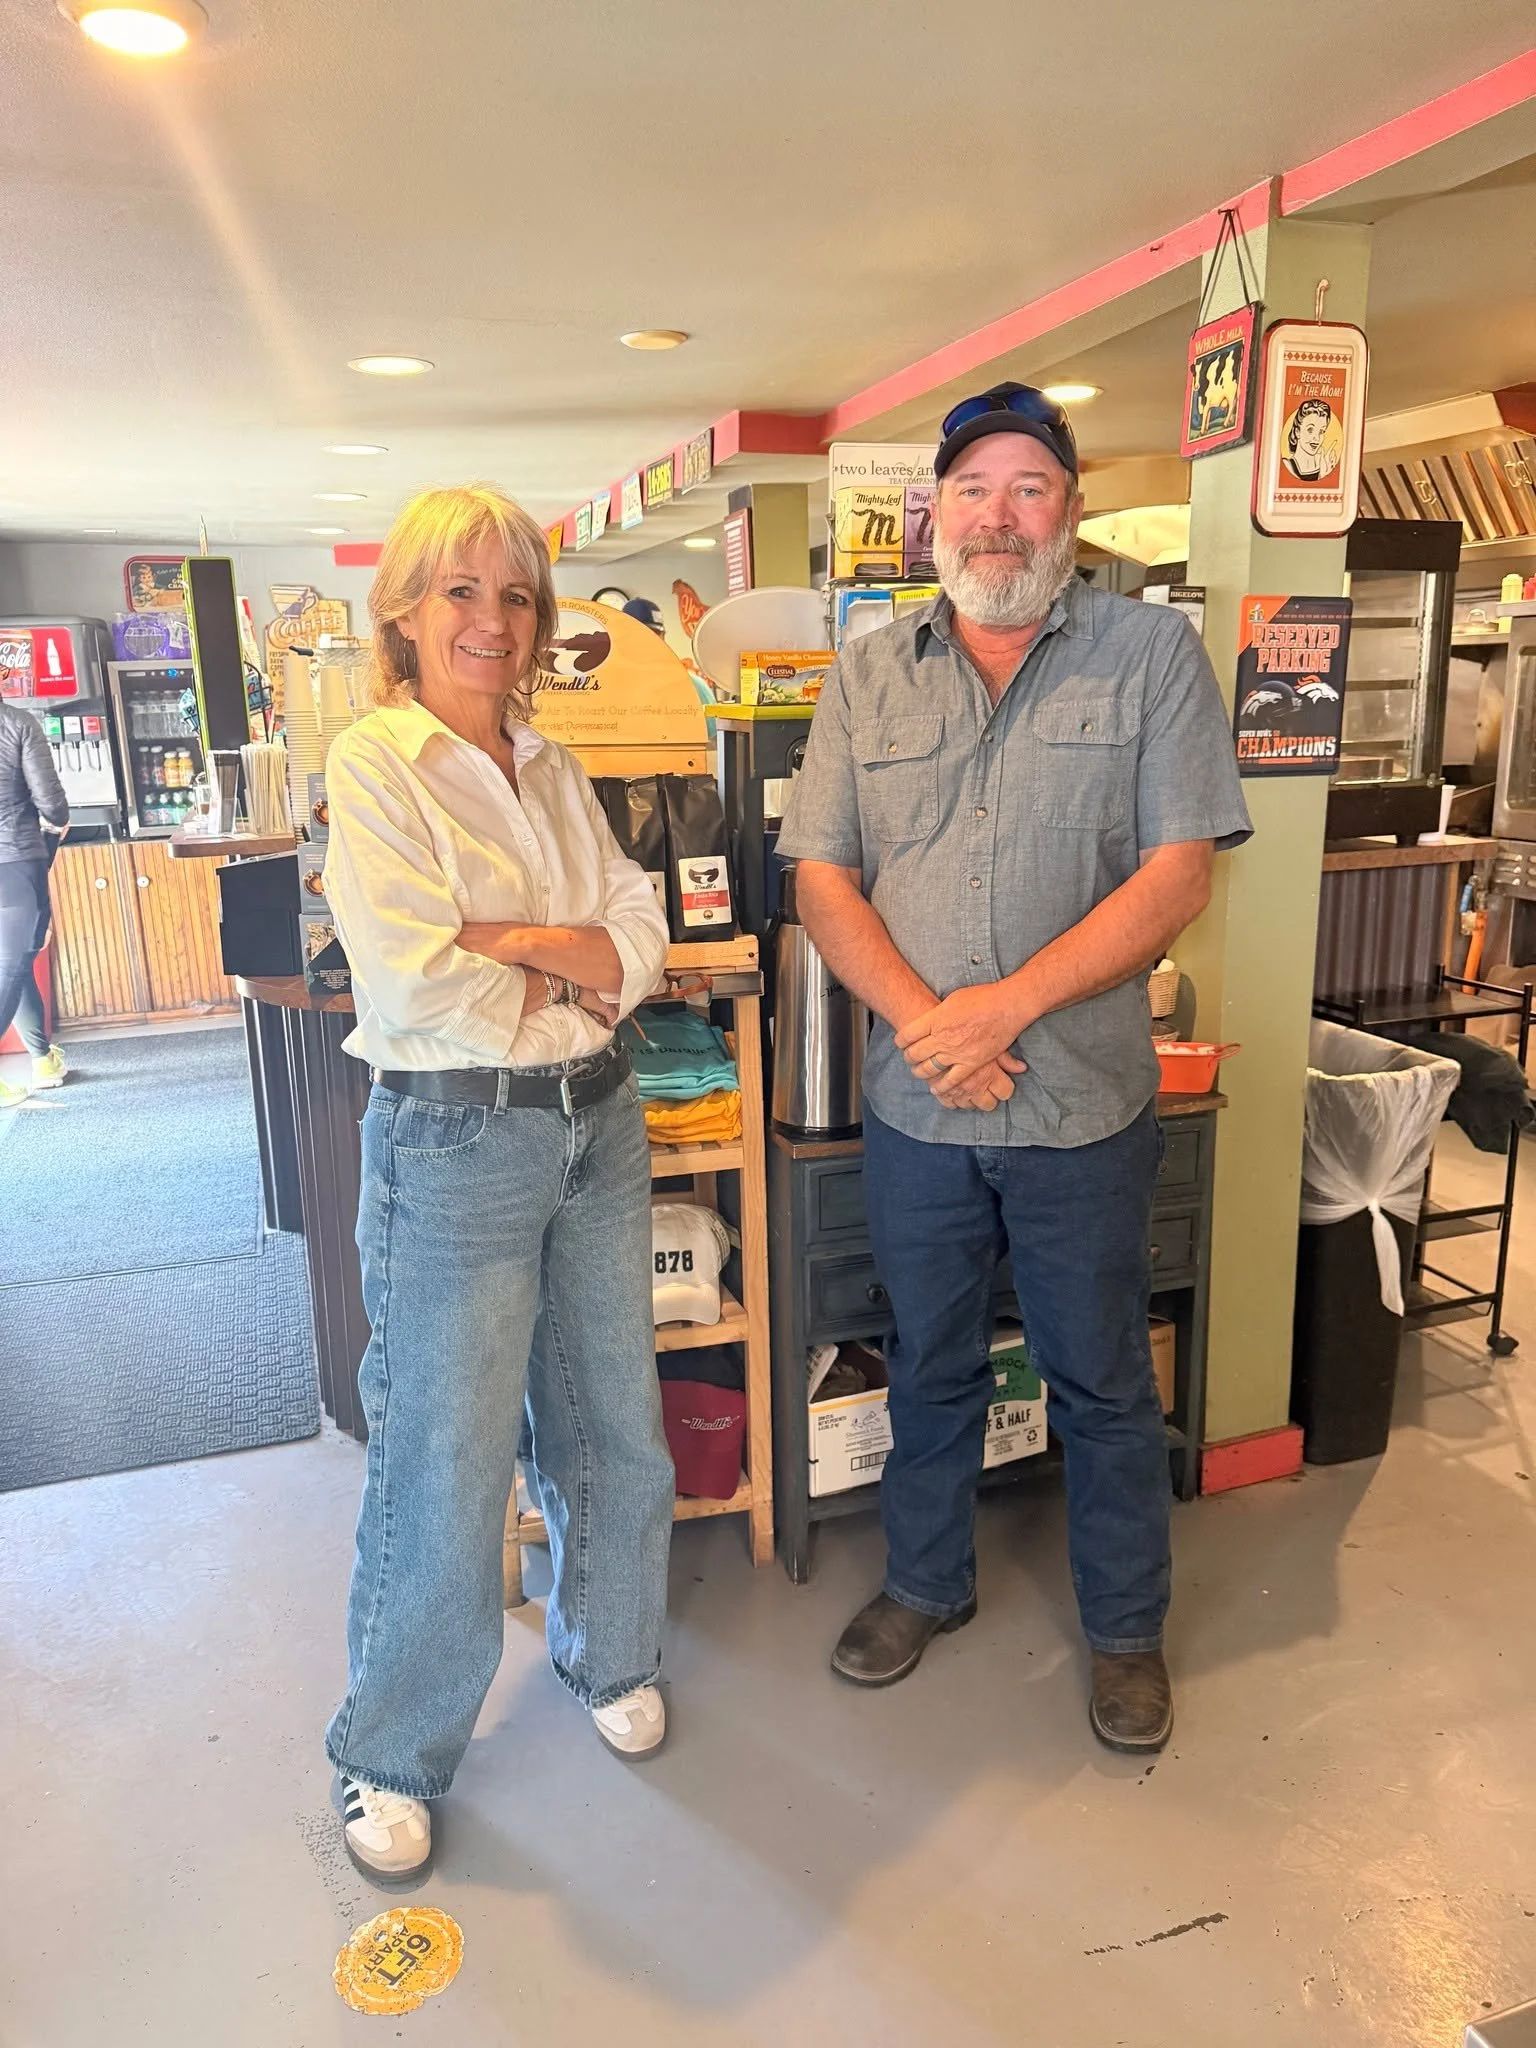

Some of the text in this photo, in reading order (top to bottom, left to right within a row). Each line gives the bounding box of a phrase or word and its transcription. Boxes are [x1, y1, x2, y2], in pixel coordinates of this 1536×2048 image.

[1195, 325, 1244, 355] WHOLE MILK
[1300, 371, 1332, 384] BECAUSE
[1288, 383, 1343, 397] I'M THE MOM!
[839, 460, 934, 476] two leaves an
[855, 493, 902, 506] Mighty Leaf
[568, 602, 609, 625] ROASTERS
[1251, 623, 1341, 649] RESERVED
[1256, 648, 1332, 673] PARKING
[608, 705, 628, 716] Our
[630, 705, 662, 716] Coffee
[665, 704, 699, 718] Locally
[1237, 736, 1336, 758] CHAMPIONS
[995, 1416, 1005, 1430] &
[1008, 1408, 1032, 1427] HALF
[364, 1925, 409, 1974] APART
[377, 1934, 430, 1986] 6FT
